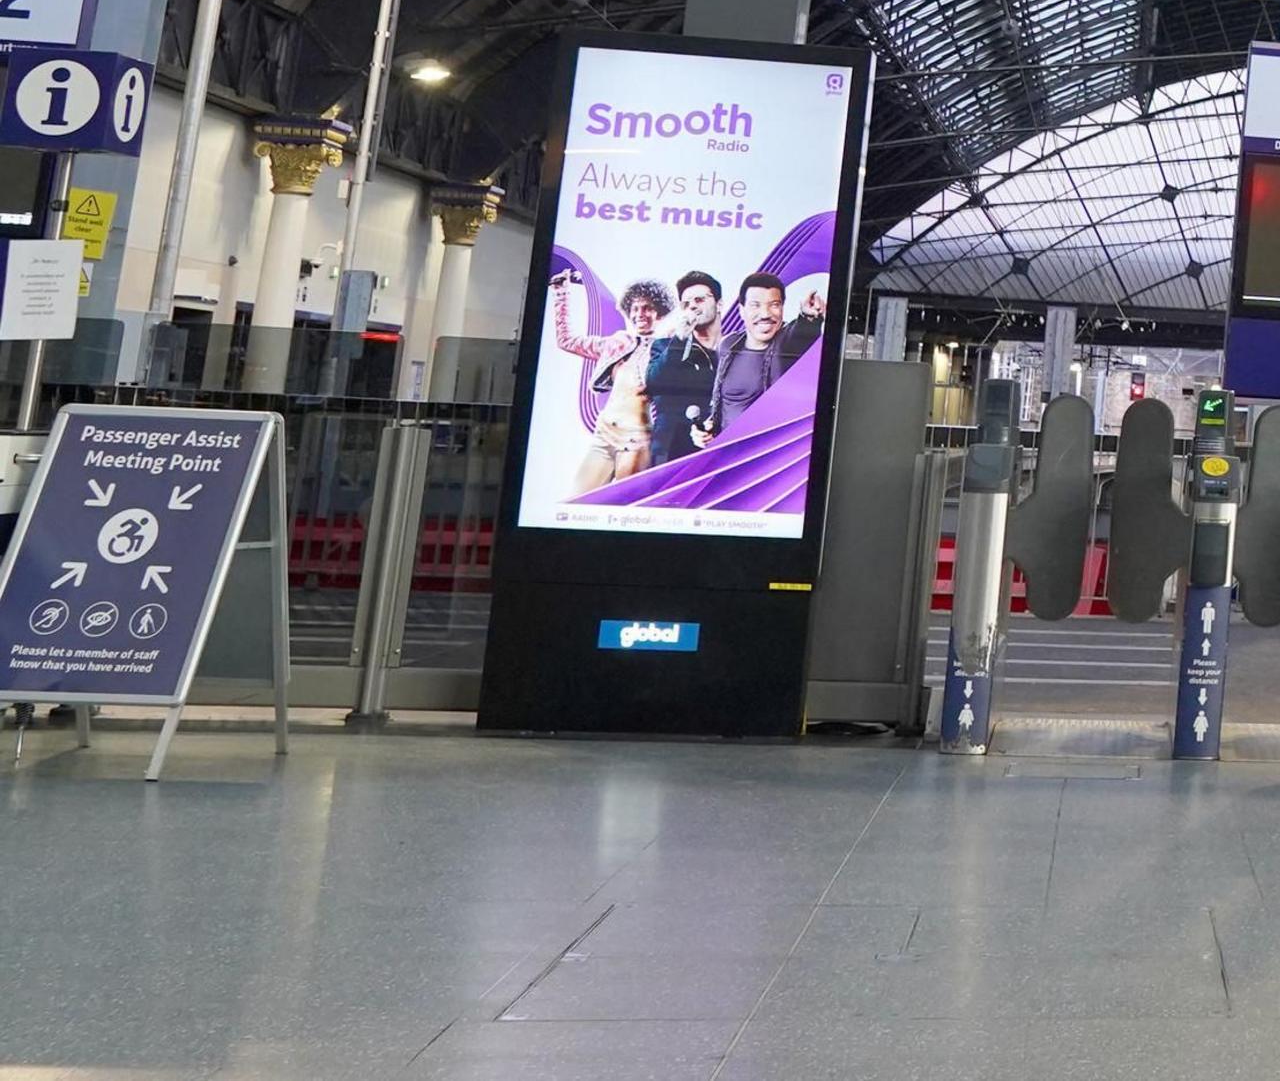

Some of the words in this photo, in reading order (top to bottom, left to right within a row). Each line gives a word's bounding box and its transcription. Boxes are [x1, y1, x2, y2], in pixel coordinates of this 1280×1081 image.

[585, 102, 753, 139] Smooth
[707, 139, 750, 153] Radio
[577, 161, 687, 200] Always
[697, 171, 747, 199] the
[575, 194, 652, 223] best
[660, 203, 764, 230] music
[80, 425, 181, 450] Passenger
[182, 429, 242, 449] Assist
[83, 449, 167, 475] Meeting
[168, 454, 222, 473] Point
[620, 623, 680, 648] global
[11, 645, 47, 657] Please
[49, 646, 64, 657] let
[64, 649, 73, 657] a
[73, 649, 119, 660] member
[120, 649, 133, 660] of
[133, 650, 160, 661] staff
[1193, 659, 1217, 667] Please
[10, 658, 40, 669] know
[41, 659, 65, 671] that
[65, 663, 86, 673] you
[86, 661, 113, 672] have
[114, 661, 153, 673] arrived
[1187, 668, 1203, 677] keep
[1204, 669, 1221, 677] your
[1189, 677, 1219, 685] distance
